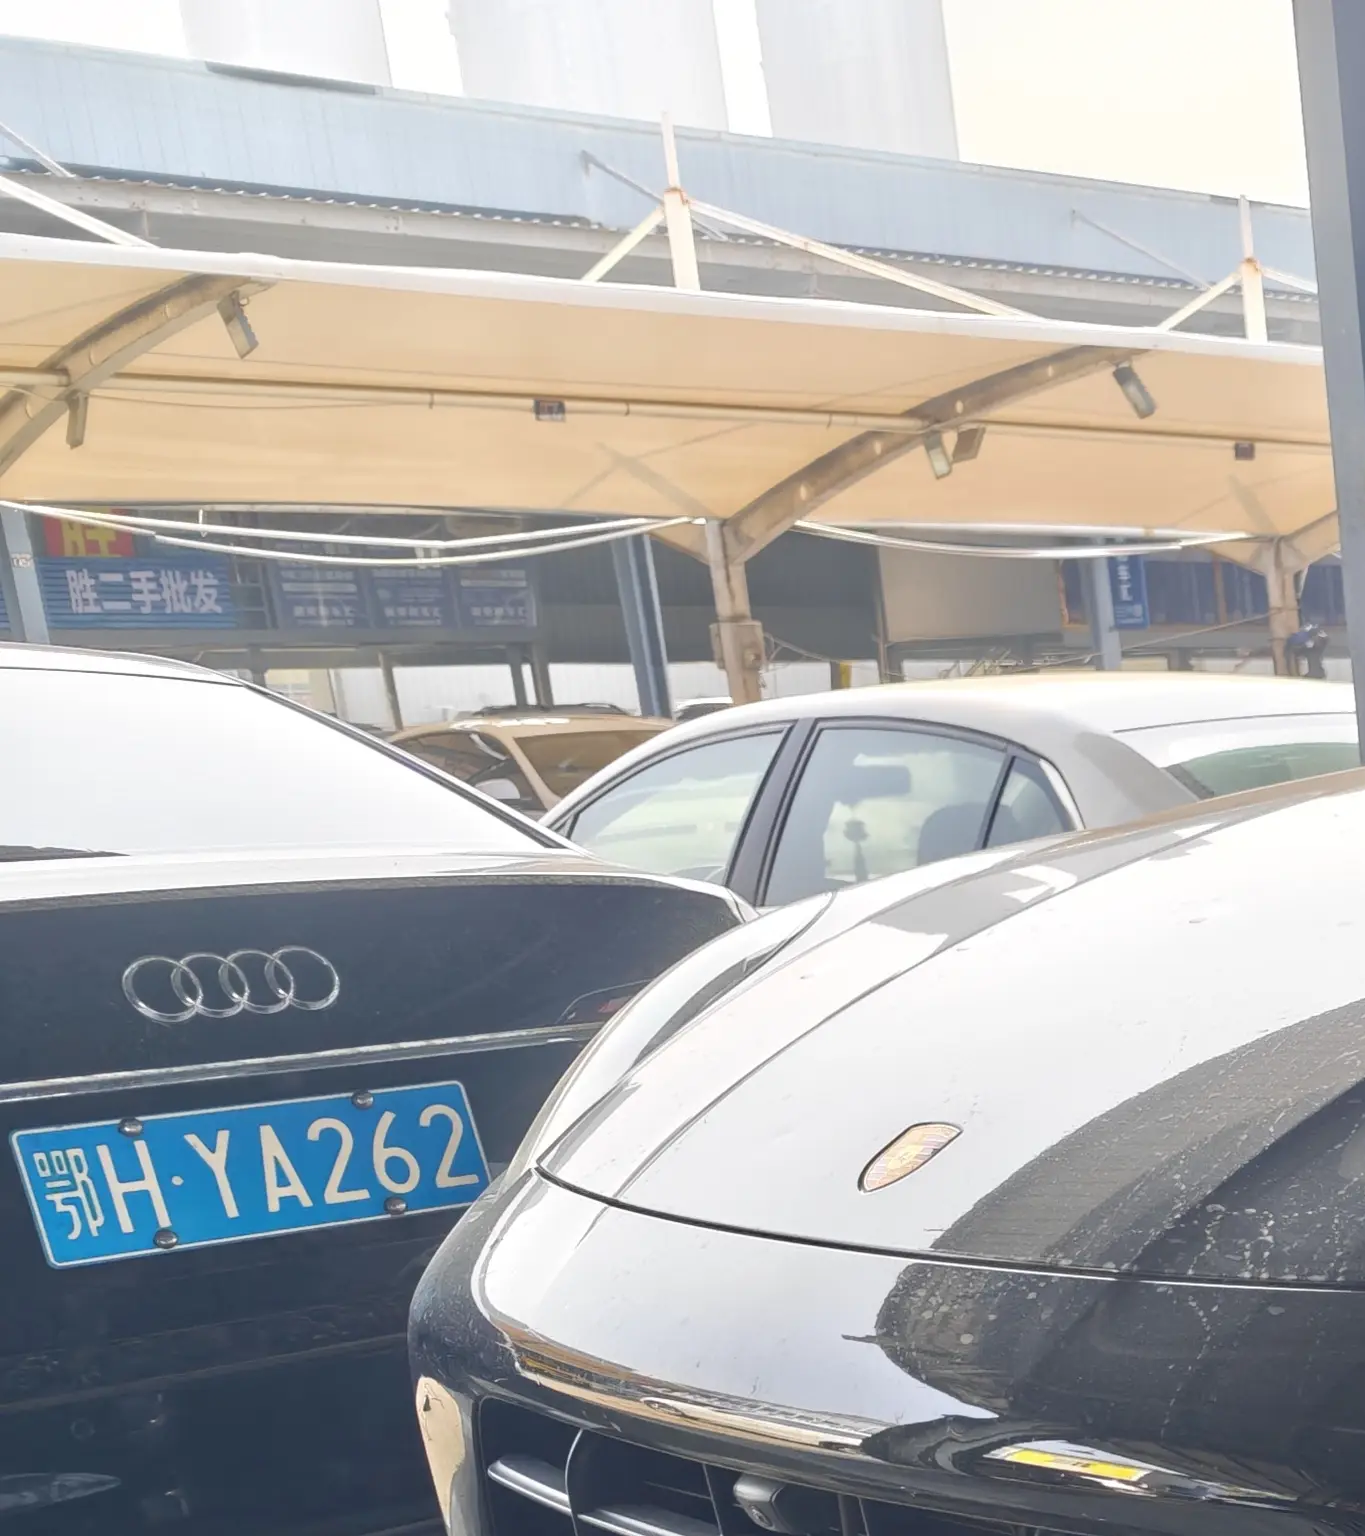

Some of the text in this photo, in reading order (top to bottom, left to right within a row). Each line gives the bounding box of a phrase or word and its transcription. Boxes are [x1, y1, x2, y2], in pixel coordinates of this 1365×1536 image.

[66, 568, 223, 614] 胜二手批发
[33, 1104, 479, 1240] 鄂H·YA262
